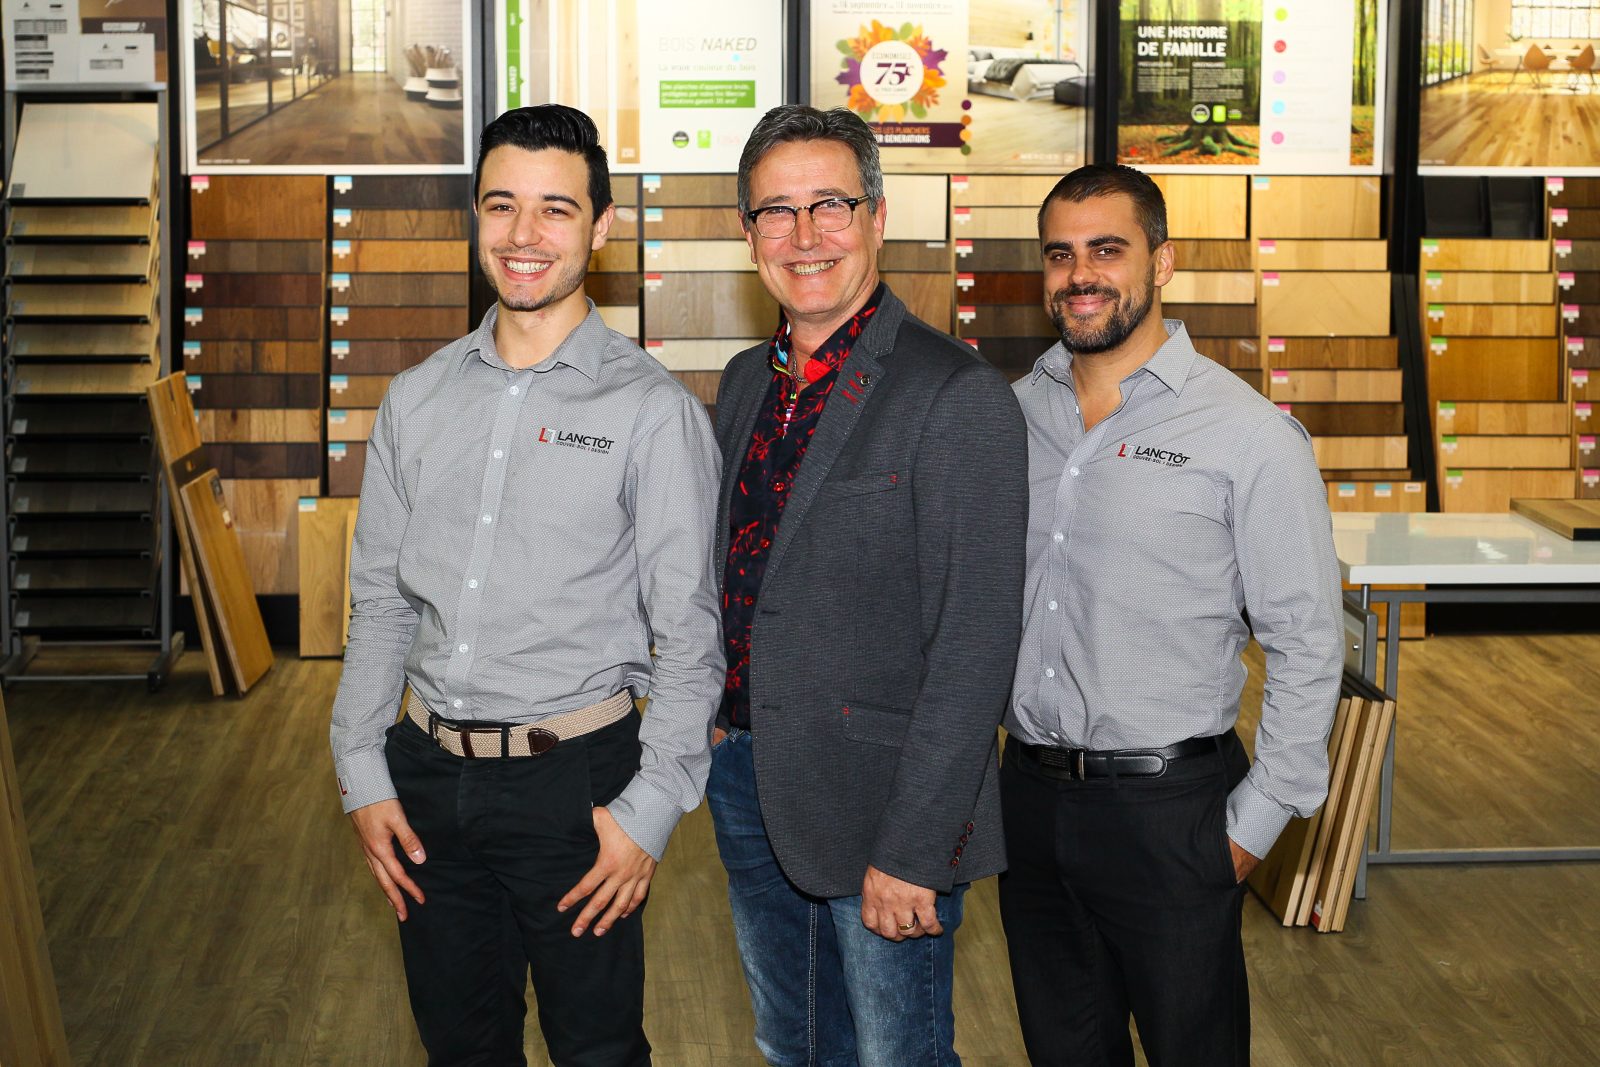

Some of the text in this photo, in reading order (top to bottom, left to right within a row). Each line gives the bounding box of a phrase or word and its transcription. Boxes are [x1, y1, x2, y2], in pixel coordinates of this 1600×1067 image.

[1137, 26, 1228, 39] UNE HISTOIRE
[658, 37, 758, 52] BOIS NAKED
[1137, 42, 1227, 57] DE FAMILLE
[883, 126, 894, 134] LES
[895, 126, 930, 134] PLANCHERS
[557, 431, 614, 449] LANCTÔT
[1135, 446, 1191, 464] LANCTÔT
